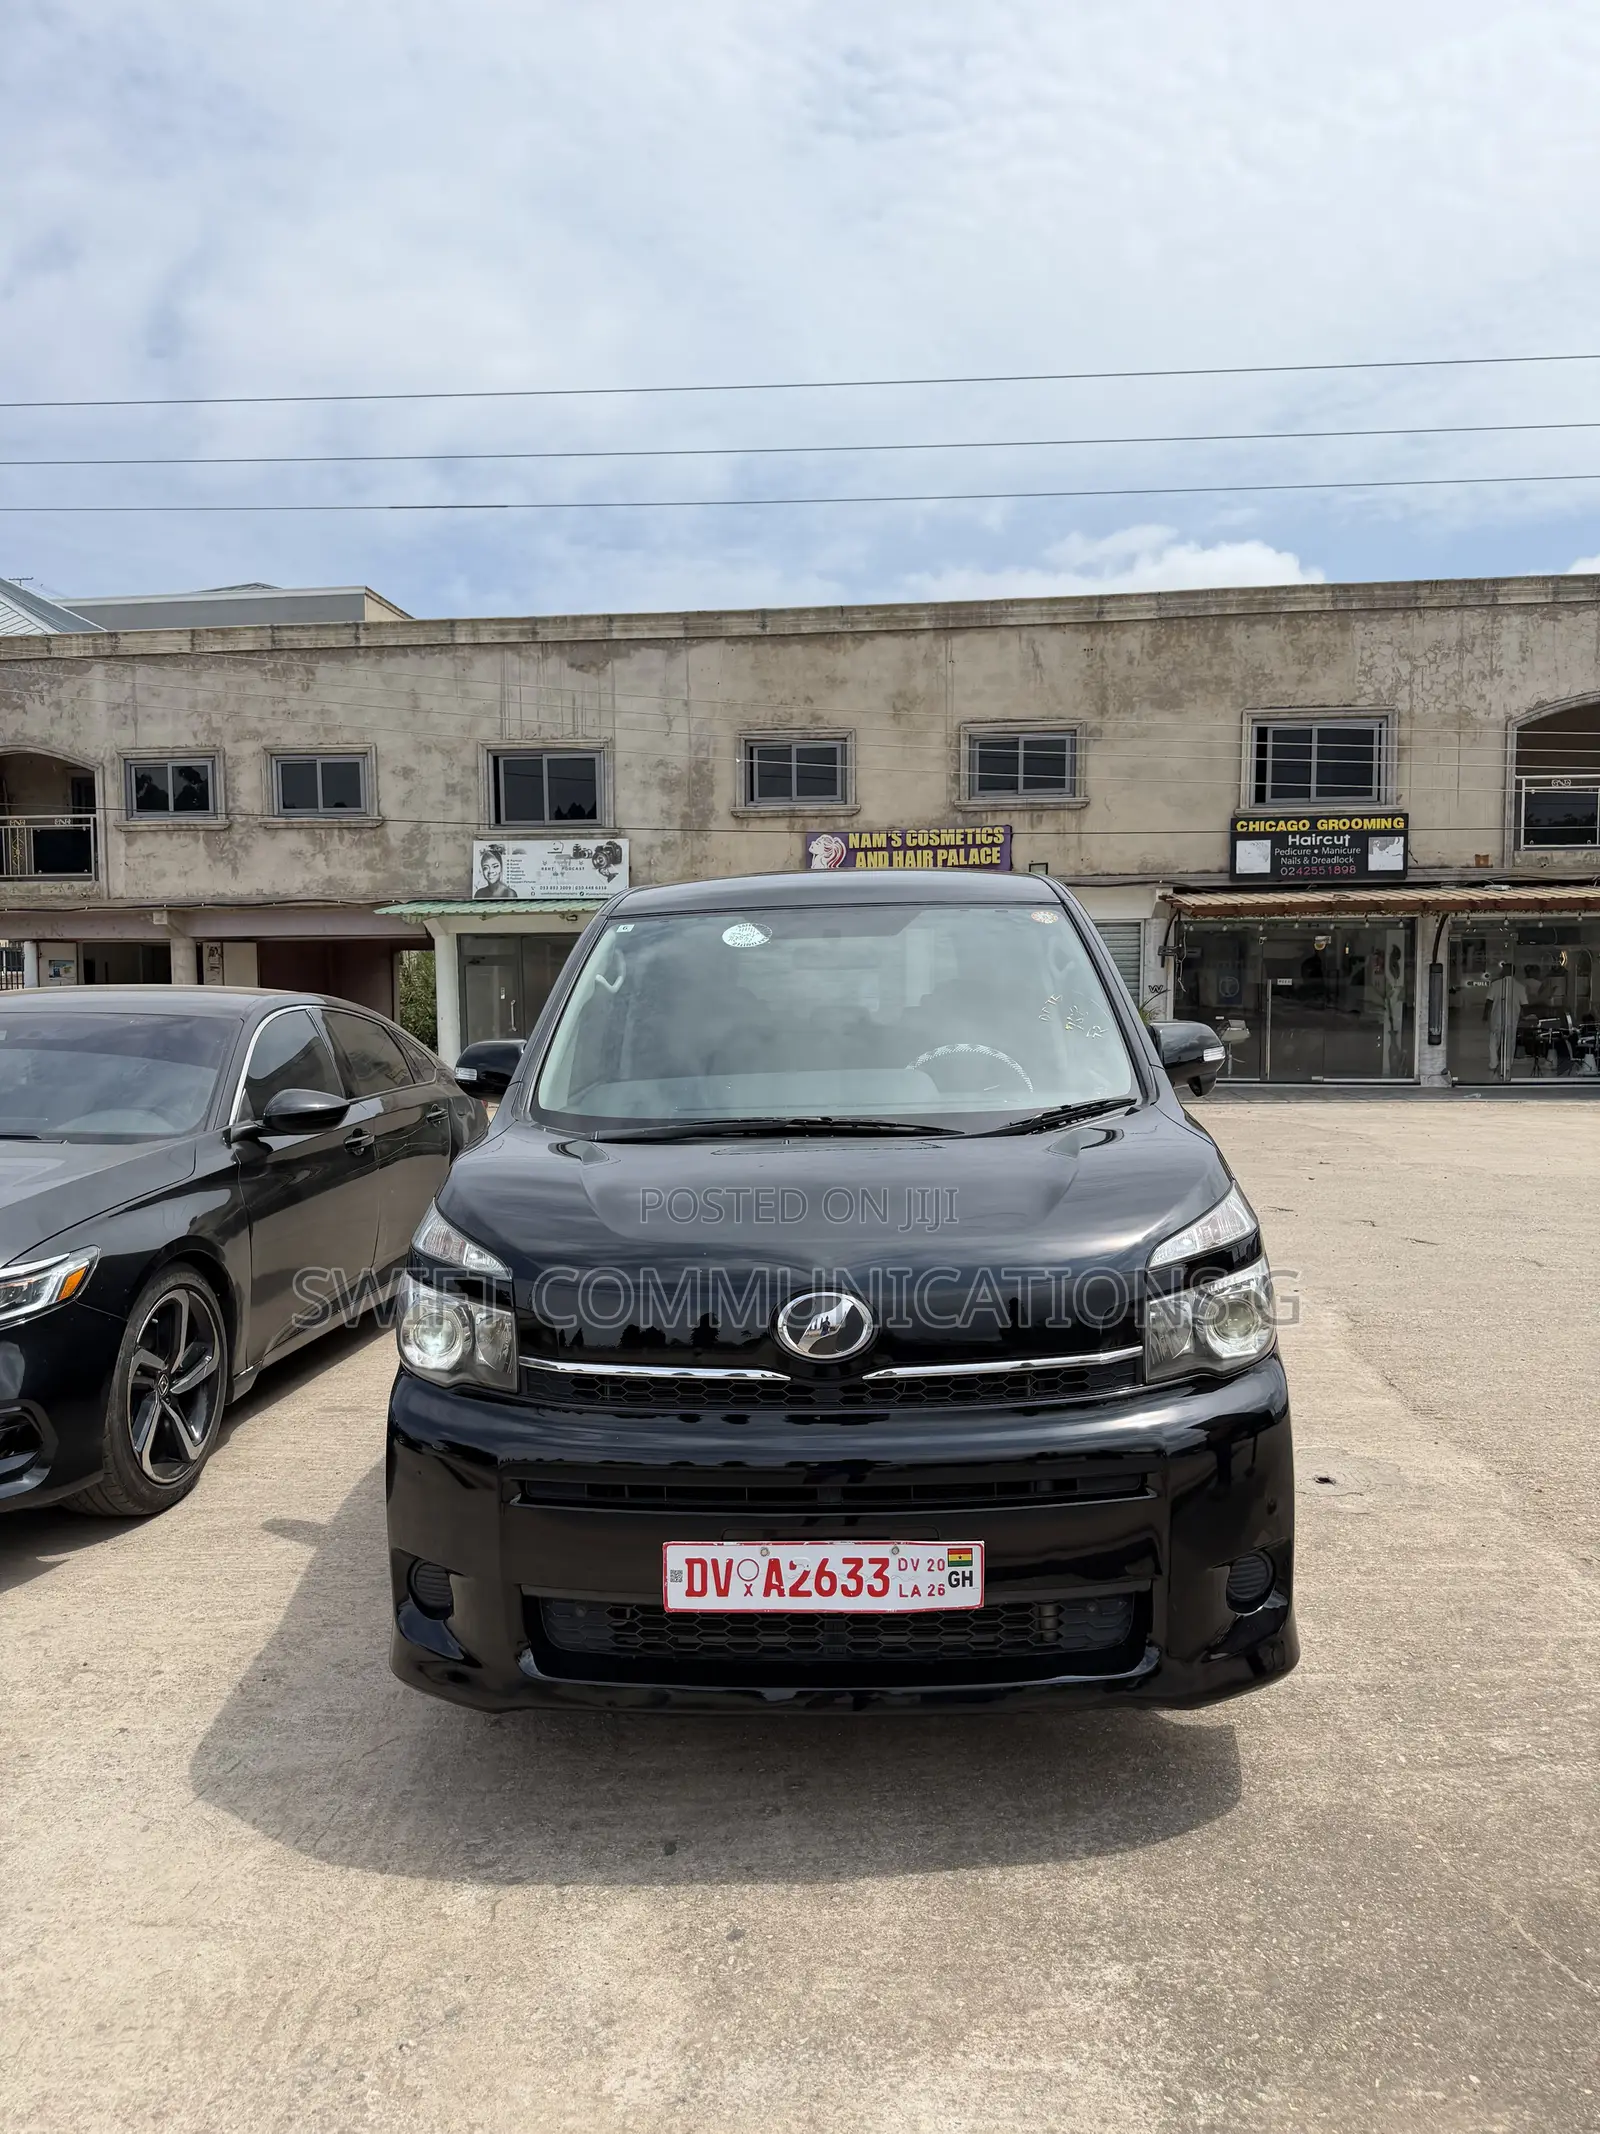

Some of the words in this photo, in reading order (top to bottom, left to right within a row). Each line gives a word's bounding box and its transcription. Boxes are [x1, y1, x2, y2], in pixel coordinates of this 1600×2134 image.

[1236, 819, 1311, 832] CHICAGO
[1316, 817, 1405, 831] GROOMING
[849, 831, 901, 849] NAM'S
[906, 827, 1004, 846] COSMETICS
[1288, 833, 1351, 847] Haircut
[855, 851, 889, 868] AND
[893, 850, 934, 868] HAIR
[938, 847, 1001, 868] PALACE
[1274, 847, 1312, 857] Pedicure
[1321, 846, 1362, 856] Manicure
[1280, 856, 1302, 866] Nails
[1303, 856, 1310, 865] &
[1311, 855, 1355, 865] Dreadlock
[898, 1557, 920, 1572] DV
[927, 1557, 946, 1573] 20
[685, 1557, 734, 1598] DV
[762, 1557, 891, 1598] A2633
[948, 1570, 974, 1588] GH
[898, 1583, 922, 1598] LA
[927, 1583, 946, 1597] 26
